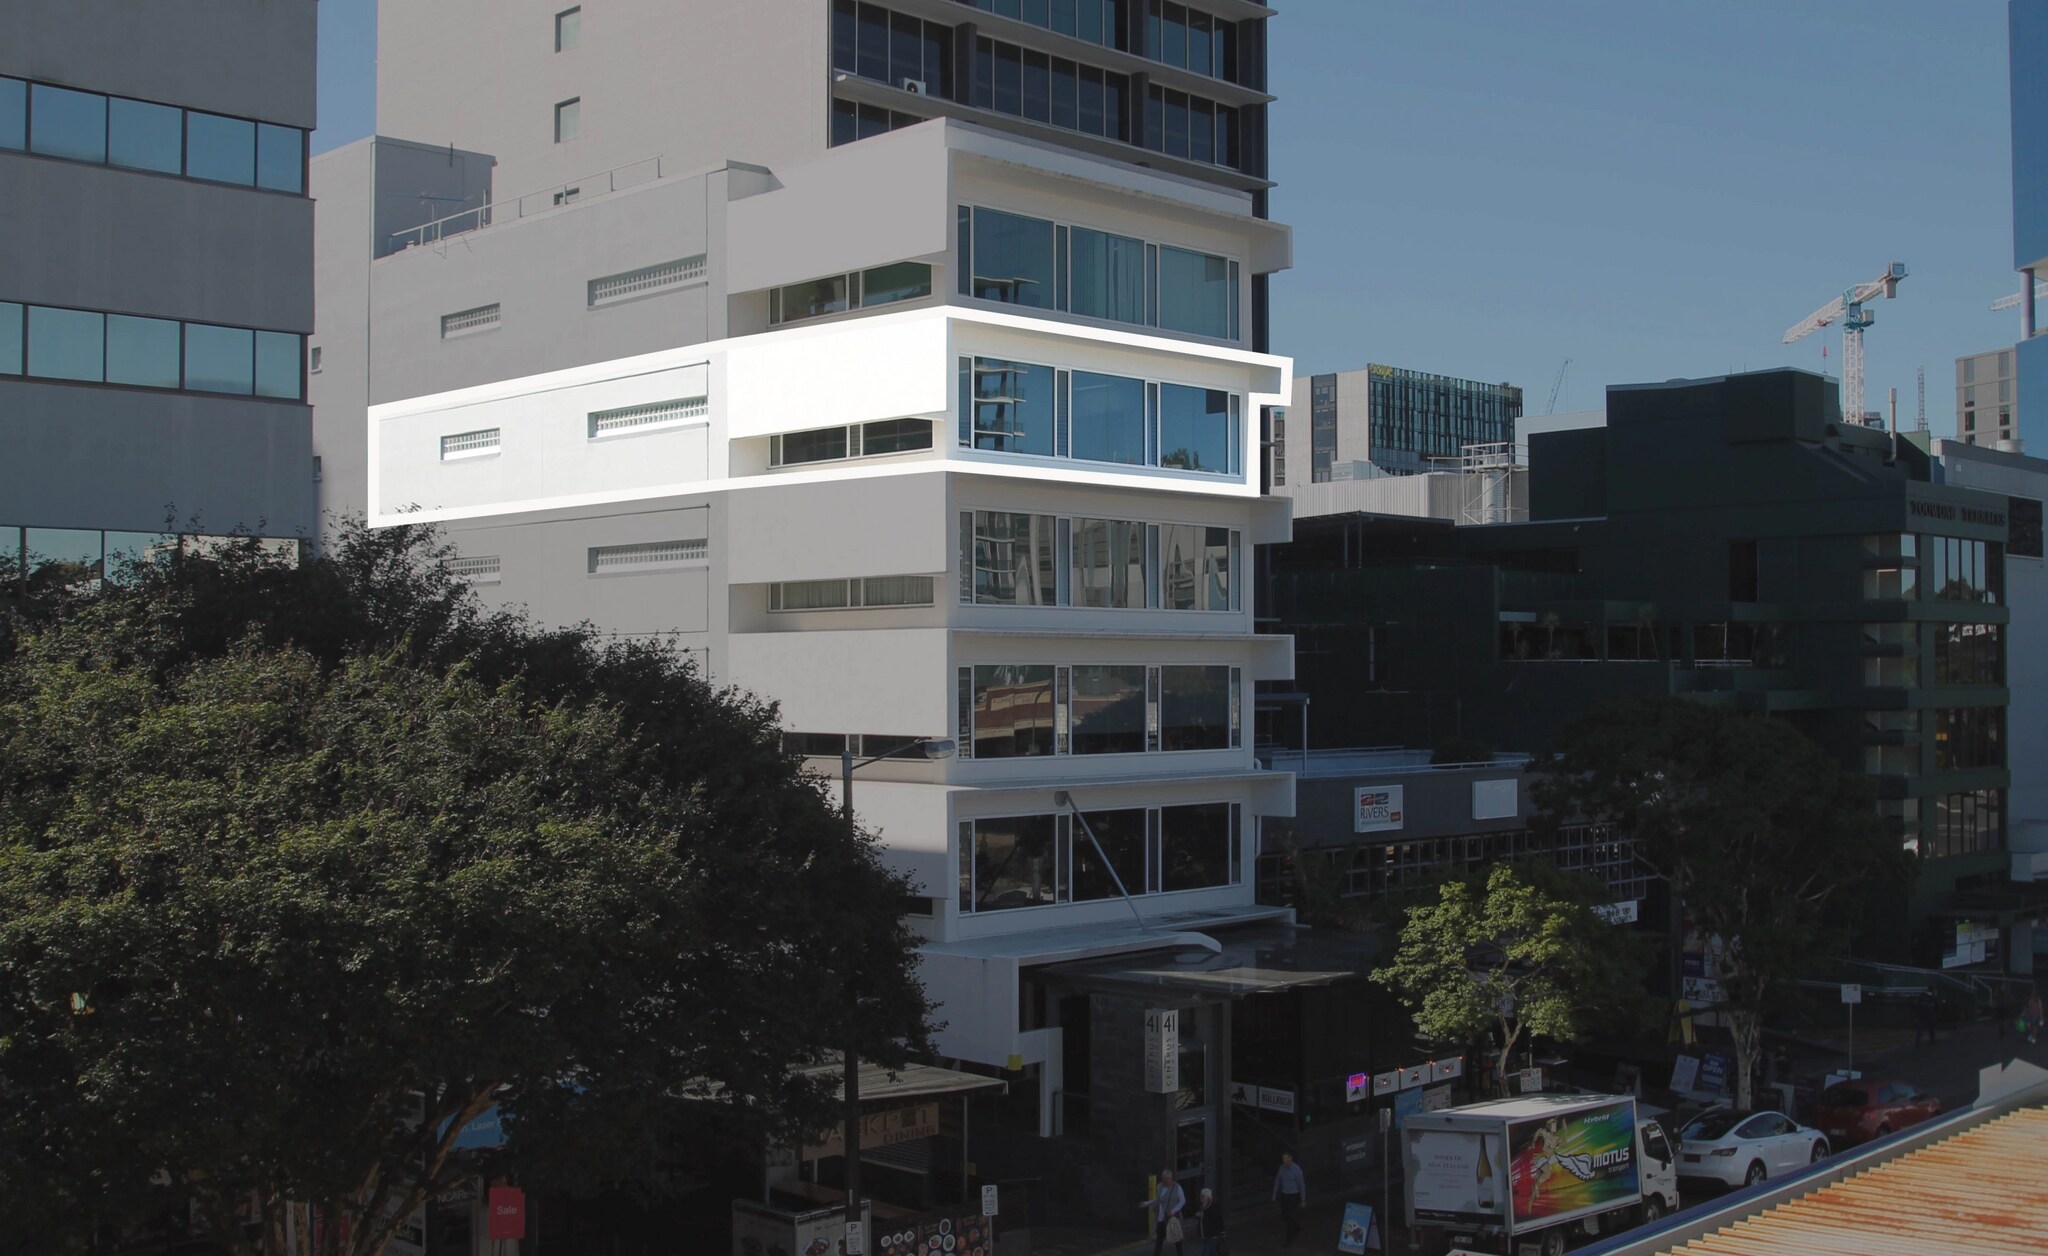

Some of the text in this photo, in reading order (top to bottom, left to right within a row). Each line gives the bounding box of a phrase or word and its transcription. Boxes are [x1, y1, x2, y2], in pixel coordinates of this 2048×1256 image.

[1910, 500, 1956, 521] TOOWONG
[1360, 806, 1389, 819] RIVERS
[1146, 1015, 1159, 1033] 41
[1163, 1014, 1175, 1033] 41
[1702, 1063, 1723, 1074] OPEN
[1261, 1092, 1292, 1106] BULLRUSH
[1583, 1113, 1610, 1124] Hybrid
[472, 1120, 495, 1131] Laser
[1593, 1147, 1629, 1168] MOTUS
[496, 1205, 518, 1216] Sale
[850, 1223, 857, 1232] P
